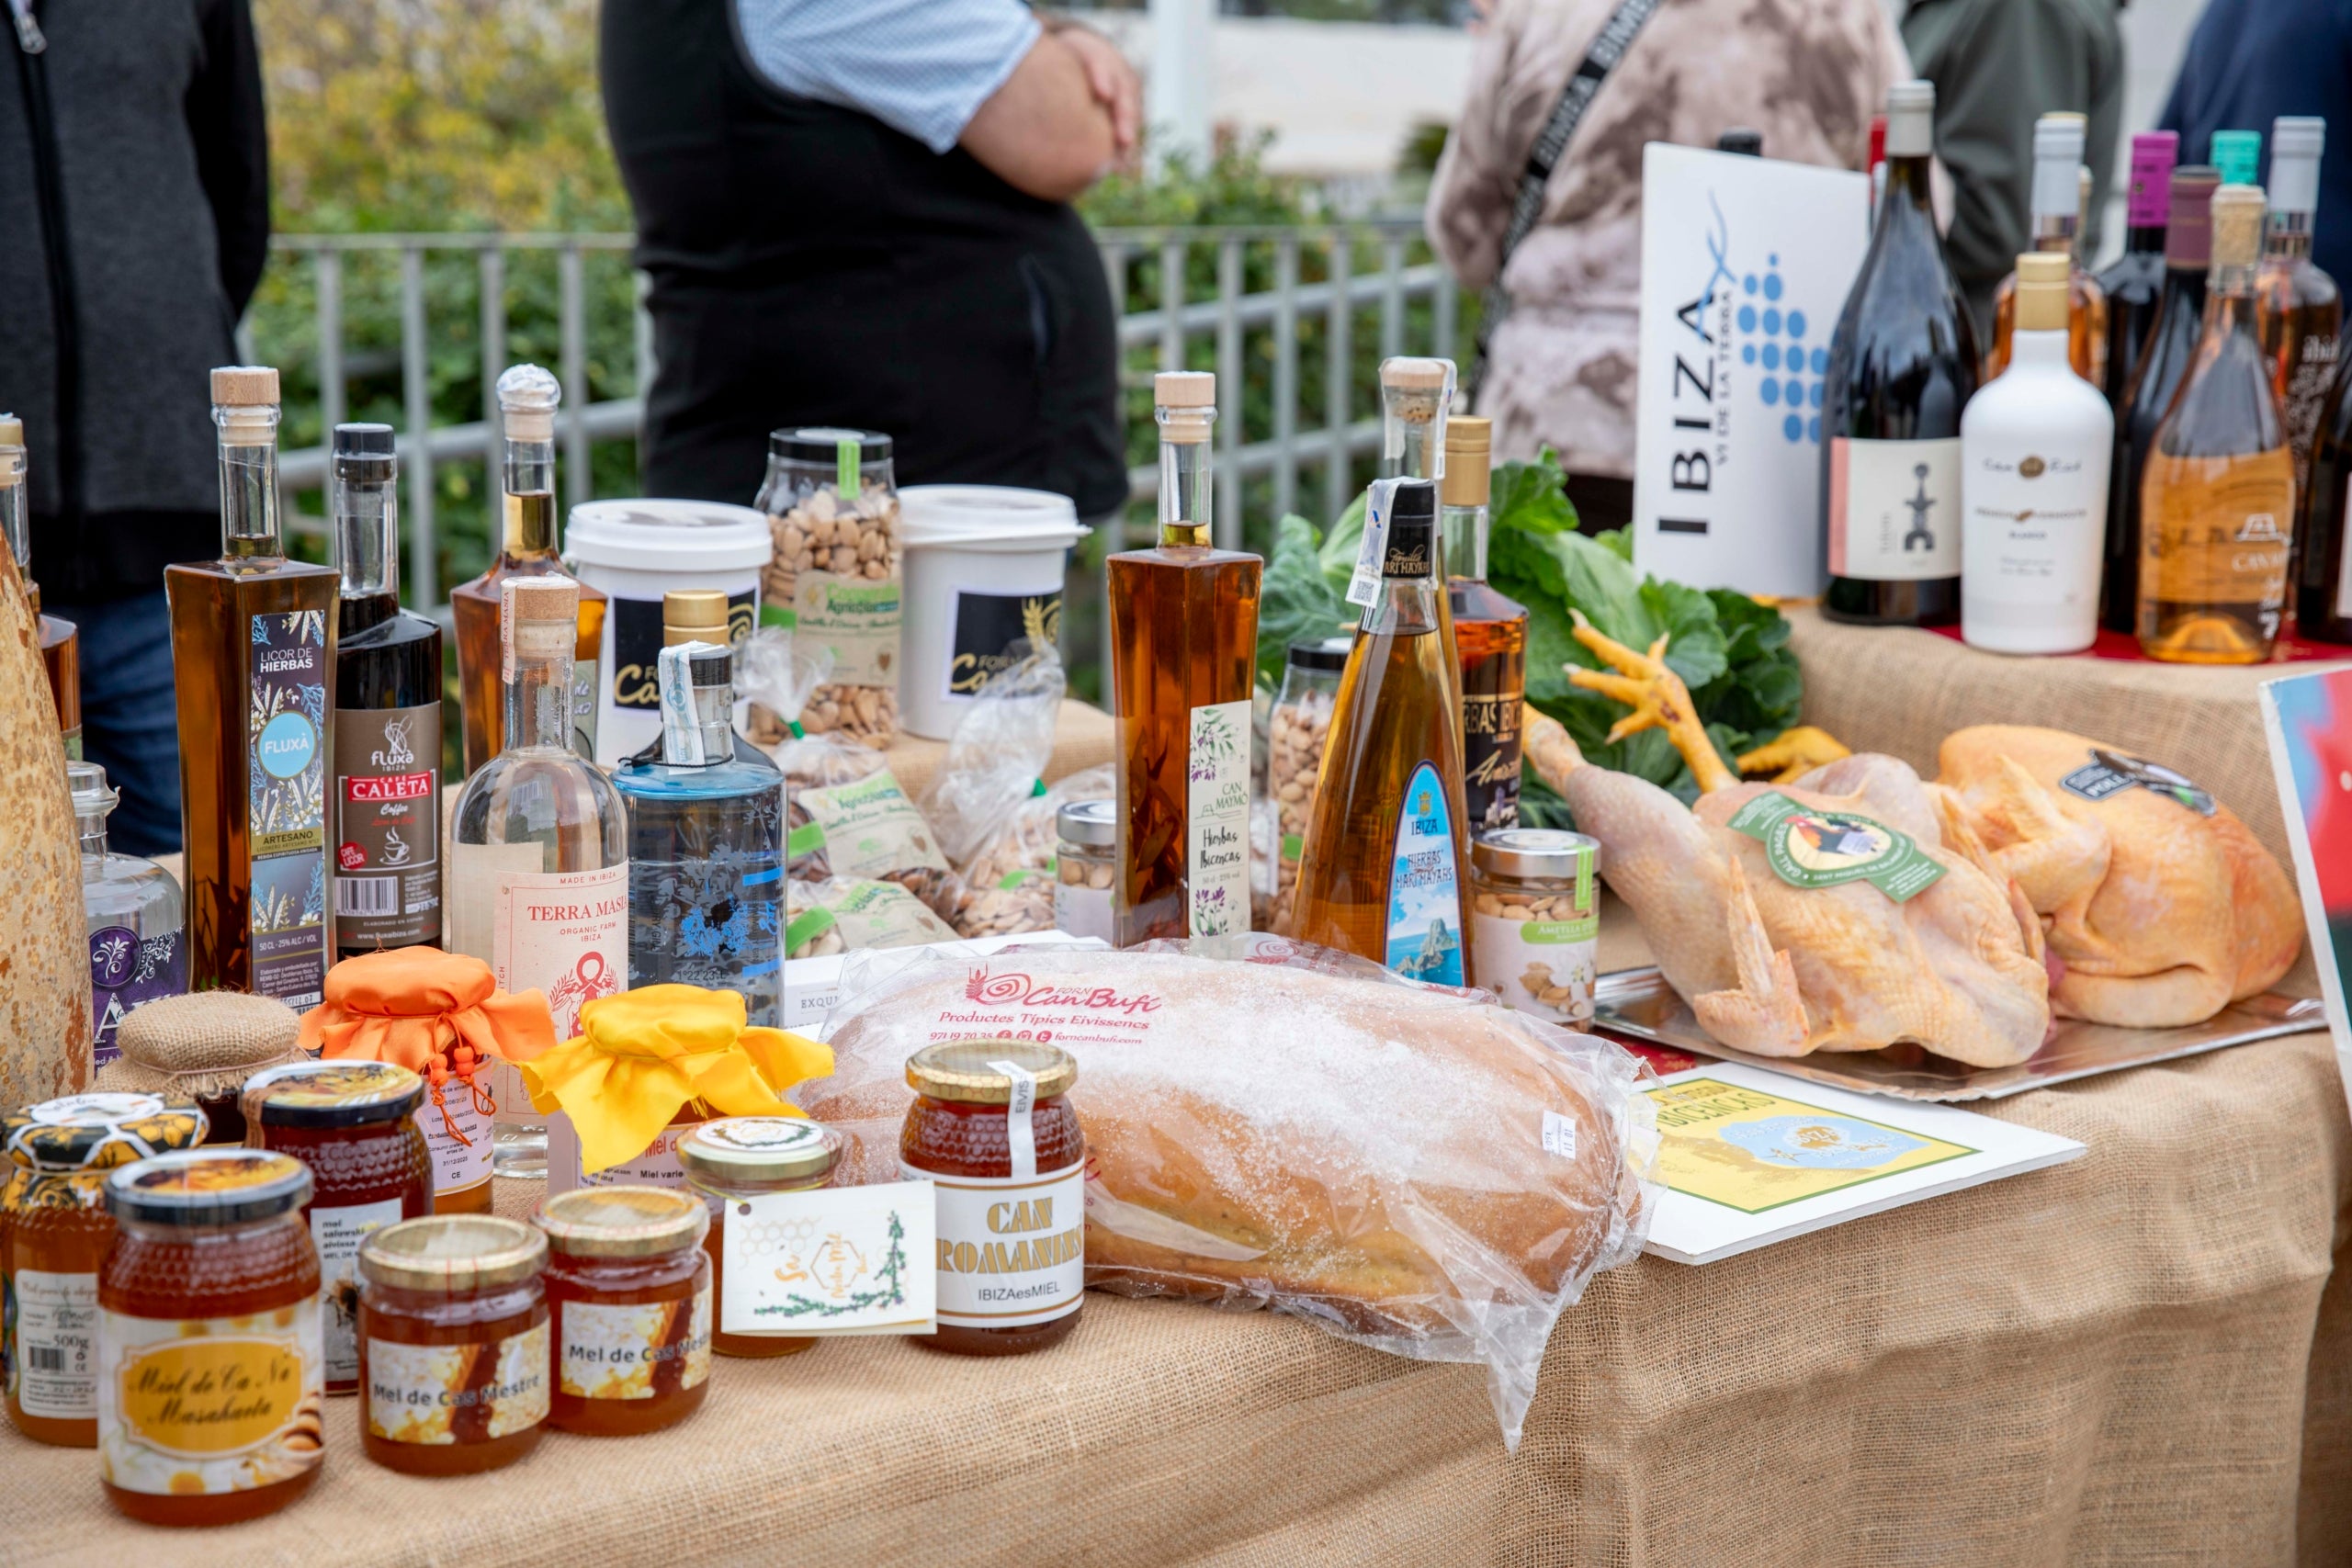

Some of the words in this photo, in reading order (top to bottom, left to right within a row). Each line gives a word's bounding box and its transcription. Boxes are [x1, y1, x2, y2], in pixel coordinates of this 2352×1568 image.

[1718, 289, 1733, 361] TERRA
[1718, 370, 1731, 398] LA
[1657, 290, 1714, 535] IBIZA
[1716, 401, 1729, 436] DE
[260, 649, 295, 662] LICOR
[298, 647, 313, 660] DE
[259, 658, 313, 673] HIERBAS
[614, 663, 660, 705] Ca
[265, 732, 310, 754] FLUXÀ
[382, 764, 406, 773] IBIZA
[353, 780, 429, 798] CALETA
[1222, 781, 1242, 795] CAN
[380, 803, 409, 816] Coffee
[1411, 818, 1438, 836] IBIZA
[263, 830, 313, 845] ARTESANO
[1204, 826, 1238, 848] Hierbas
[343, 853, 365, 868] LICOR
[599, 872, 616, 881] IBIZA
[527, 902, 593, 921] TERRA
[560, 925, 598, 935] ORGANIC
[600, 920, 616, 931] FARM
[278, 940, 290, 949] 25%
[291, 937, 302, 947] ALC
[306, 934, 317, 943] VOL
[1056, 986, 1092, 995] FORN
[939, 1010, 1014, 1023] Productes
[1021, 1012, 1066, 1026] Típics
[1070, 1015, 1150, 1030] Eivissencs
[930, 1032, 947, 1041] 971
[949, 1032, 961, 1041] 19
[964, 1032, 978, 1040] 70
[645, 1136, 666, 1157] Mel
[451, 1171, 461, 1179] CE
[640, 1170, 659, 1179] Miel
[662, 1169, 684, 1179] varie
[986, 1197, 1053, 1235] CAN
[978, 1281, 1060, 1302] IBIZAesMIEL
[53, 1335, 89, 1349] 500g
[570, 1345, 603, 1361] Mel
[610, 1348, 635, 1363] de
[641, 1345, 675, 1361] Cas
[374, 1383, 401, 1403] Mel
[406, 1388, 432, 1406] de
[437, 1390, 476, 1406] Cas
